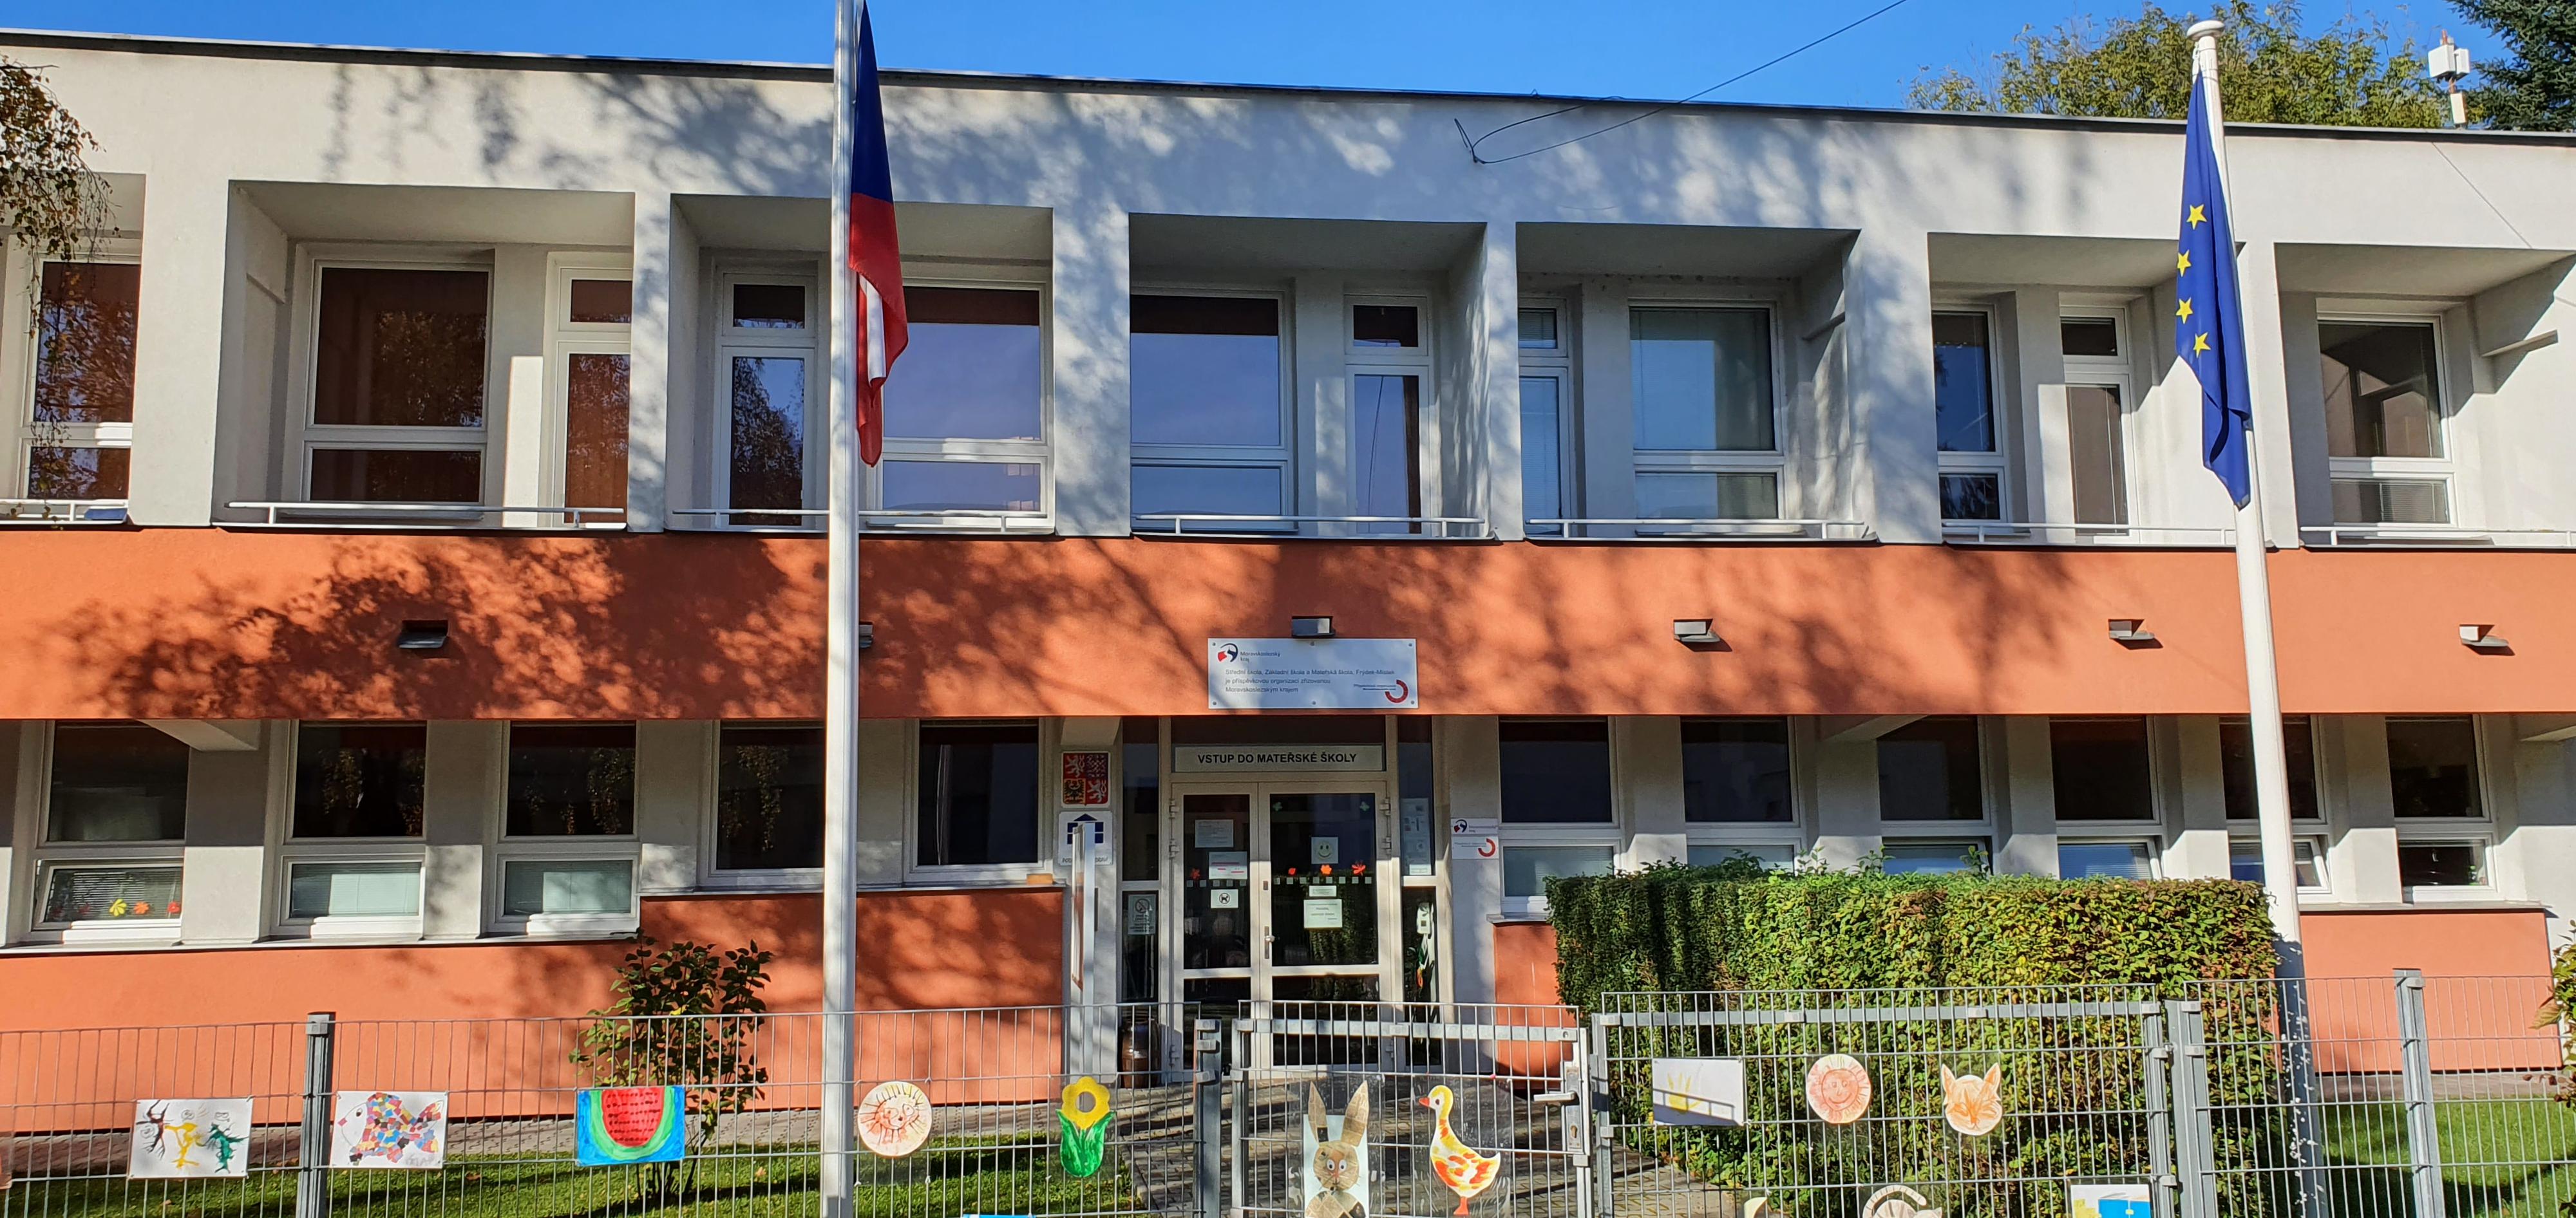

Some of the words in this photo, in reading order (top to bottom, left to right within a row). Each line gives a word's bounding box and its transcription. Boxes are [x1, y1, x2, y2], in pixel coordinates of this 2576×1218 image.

[1197, 754, 1235, 764] VSTUP
[1238, 754, 1254, 764] DO
[1257, 751, 1318, 763] MATEŘSKÉ
[1320, 751, 1357, 763] ŠKOLY
